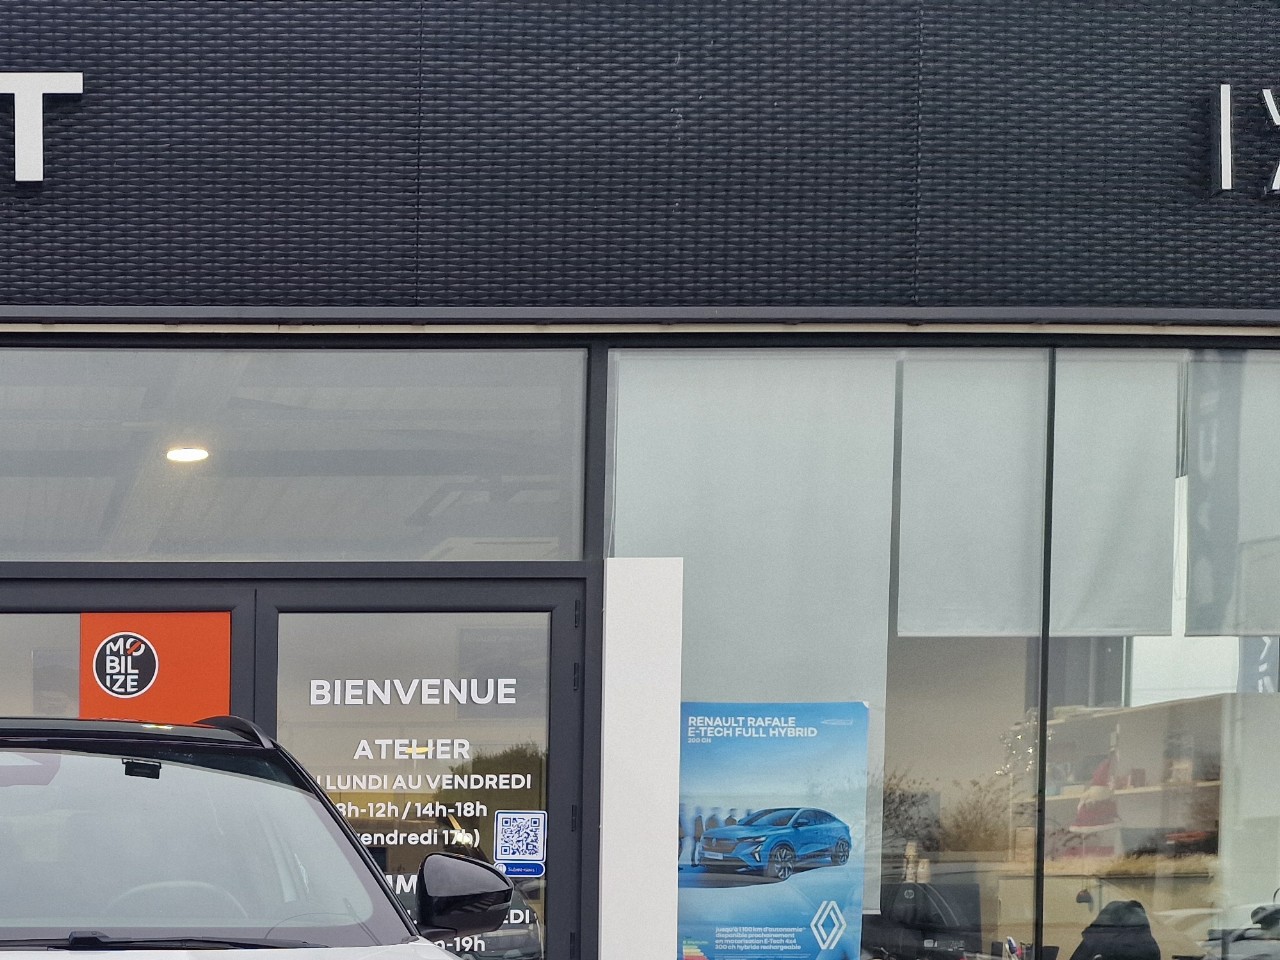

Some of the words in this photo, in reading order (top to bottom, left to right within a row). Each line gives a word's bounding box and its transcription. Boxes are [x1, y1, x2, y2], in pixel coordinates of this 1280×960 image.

[106, 655, 139, 674] BIL
[106, 674, 139, 692] IZE
[310, 678, 517, 705] BIENVENUE
[688, 716, 745, 727] RENAULT
[747, 716, 796, 727] RAFALE
[688, 727, 733, 738] E-TECH
[735, 727, 767, 738] FULL
[769, 727, 818, 738] HYBRID
[353, 739, 471, 760] ATELIER
[326, 774, 388, 790] LUNDI
[392, 774, 422, 790] AU
[426, 774, 532, 790] VENDREDI
[335, 801, 400, 818] 8h-12h
[415, 800, 488, 818] 14h-18h
[442, 829, 481, 848] 17h)
